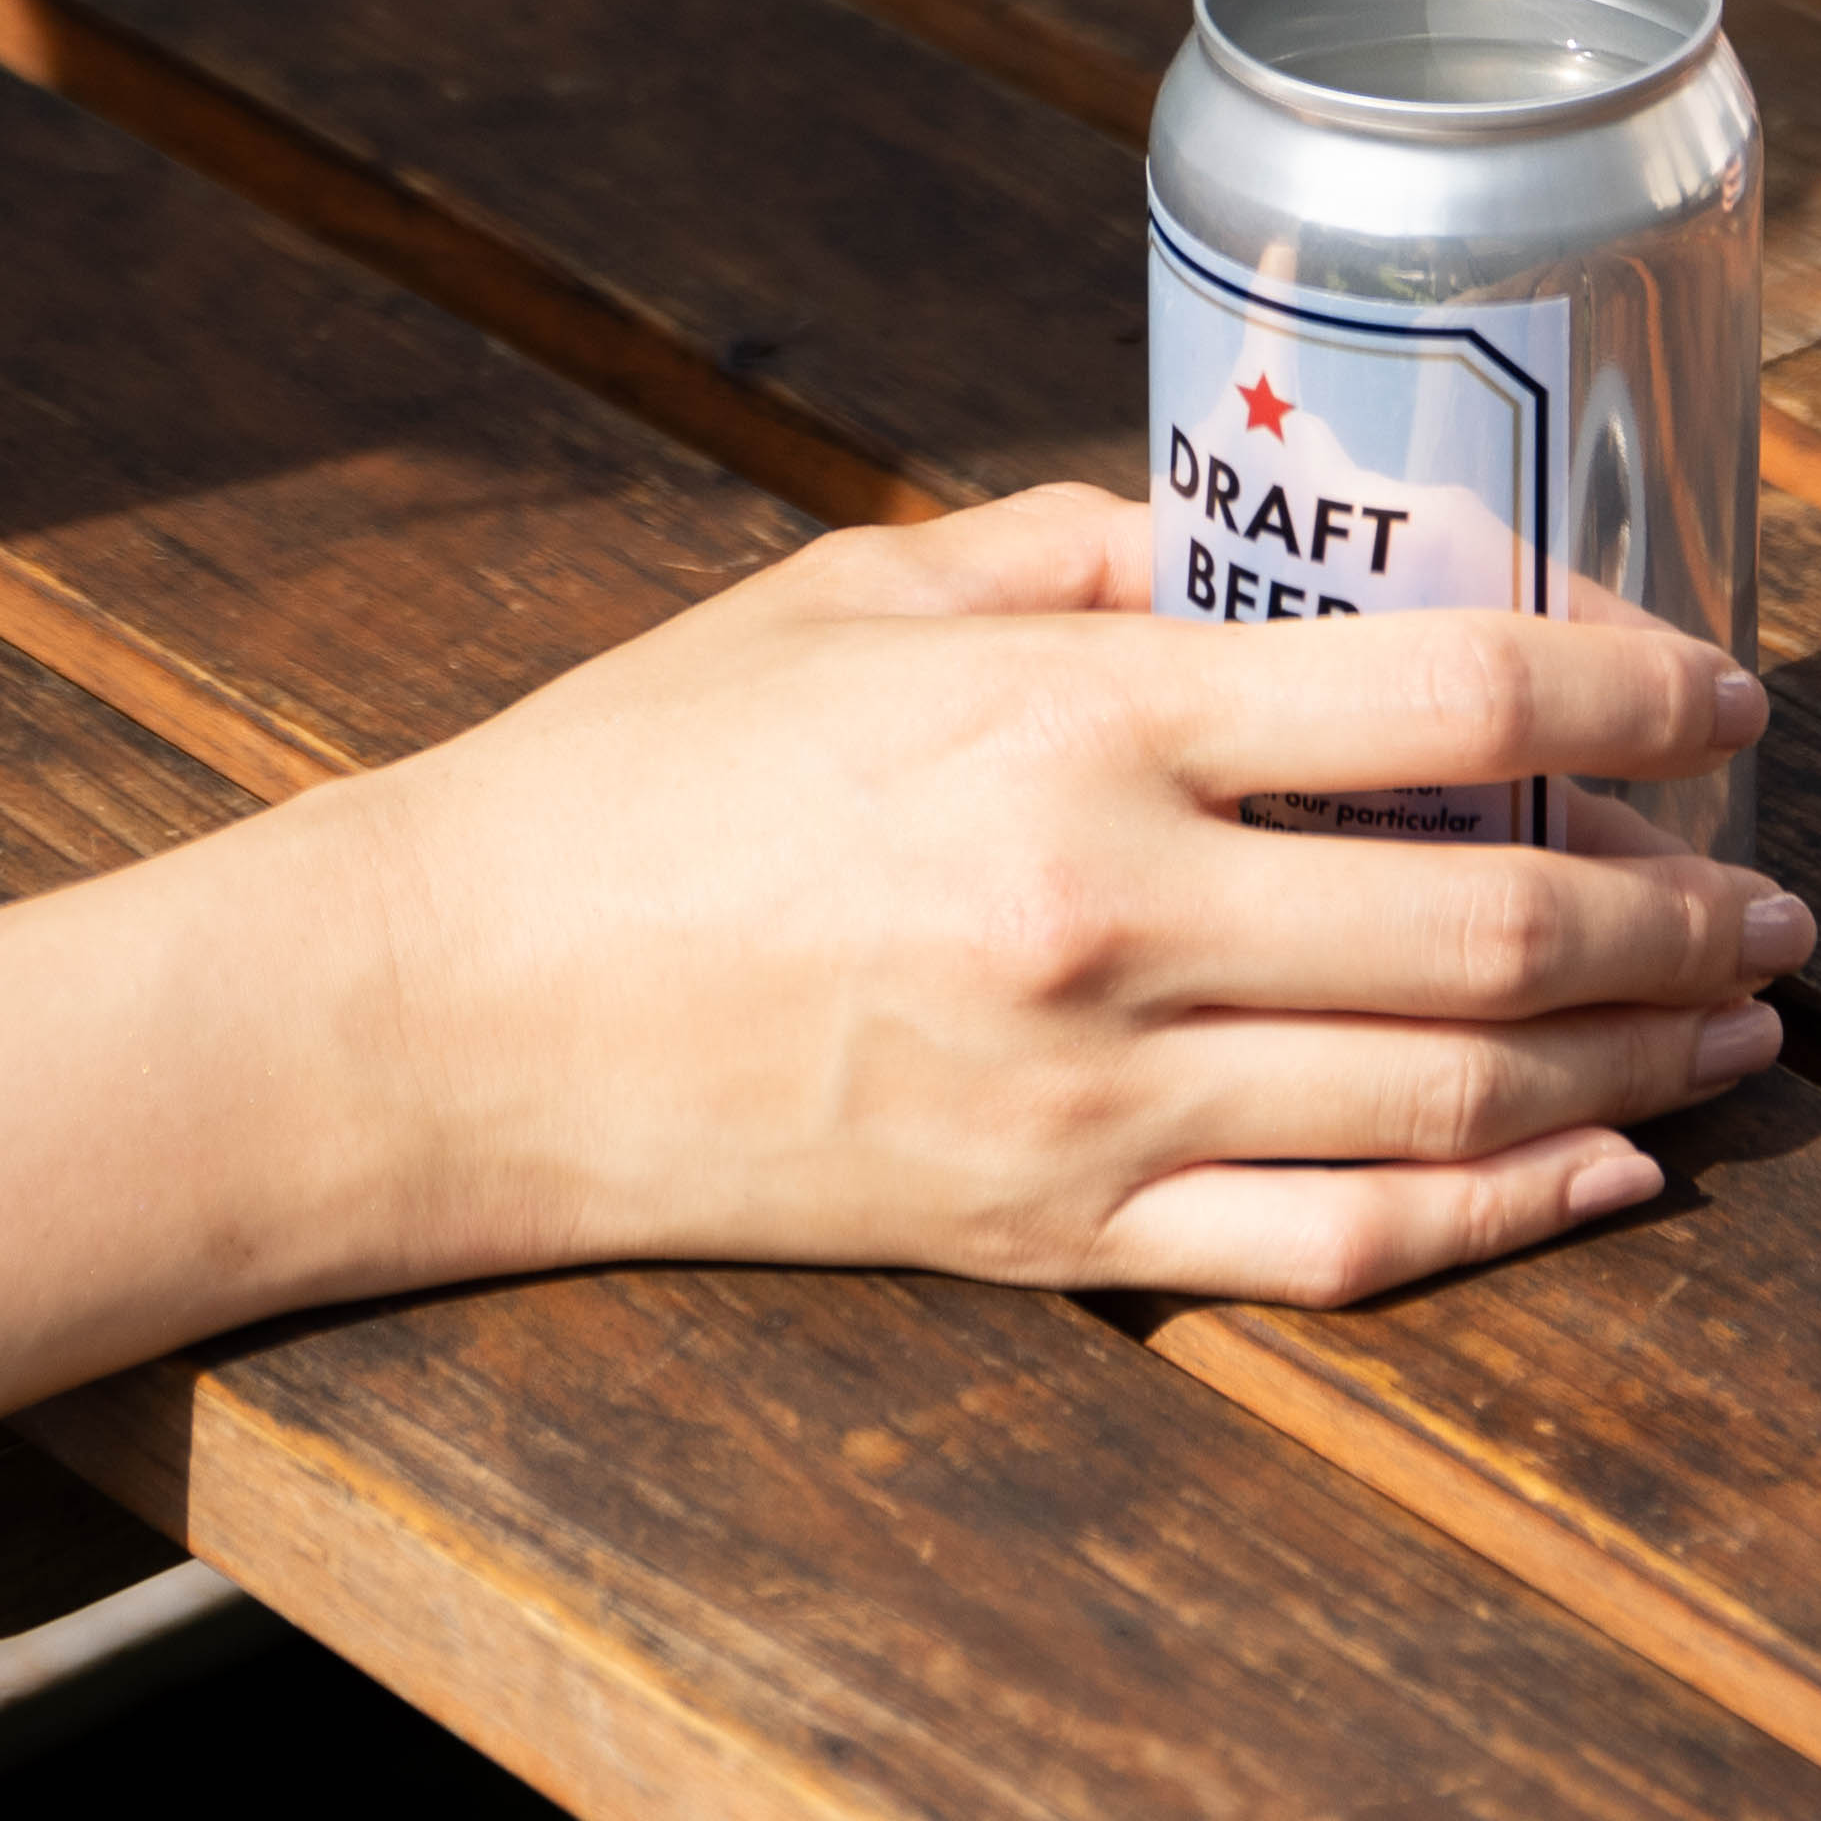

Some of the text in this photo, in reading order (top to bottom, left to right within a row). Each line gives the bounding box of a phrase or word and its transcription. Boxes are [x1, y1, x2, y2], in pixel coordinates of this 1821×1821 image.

[1169, 422, 1409, 576] DRAFT
[1285, 791, 1331, 816] our
[1335, 804, 1481, 834] particular
